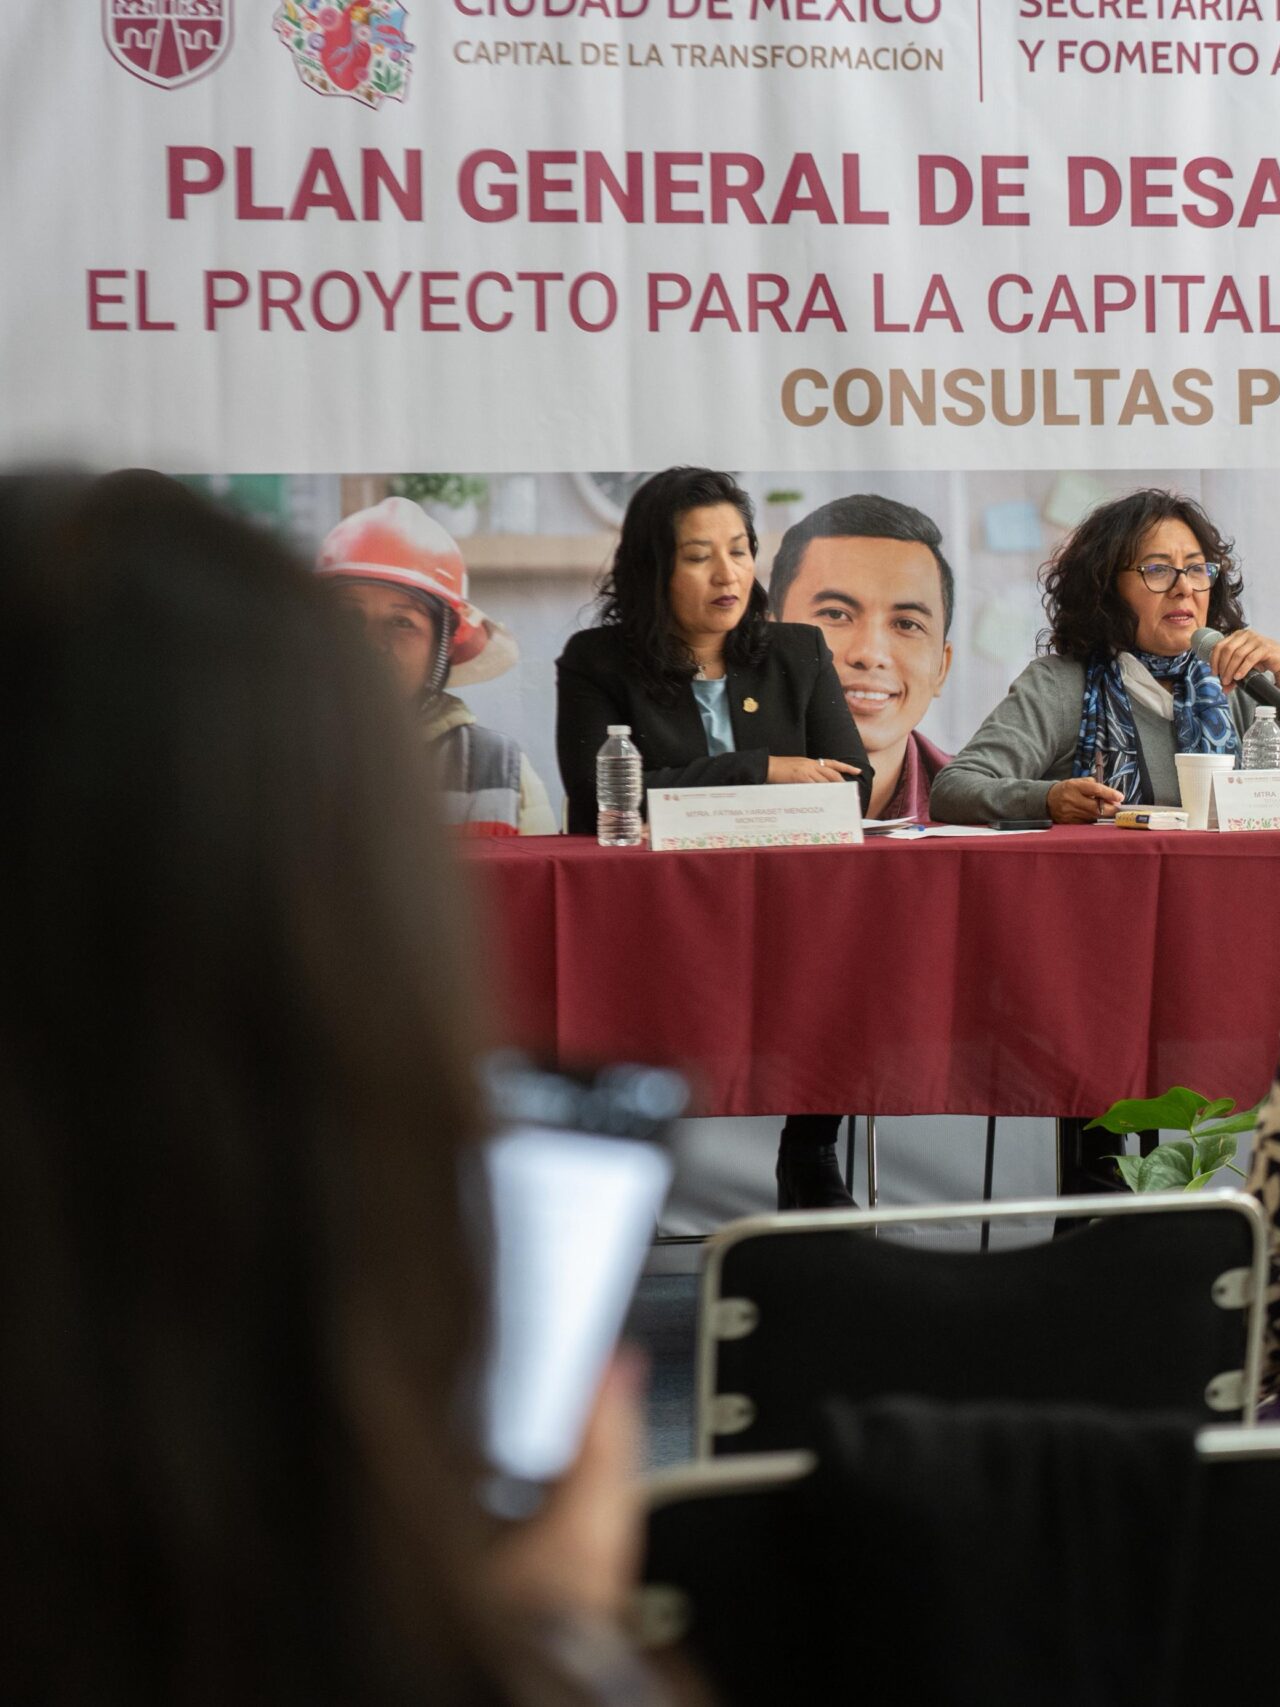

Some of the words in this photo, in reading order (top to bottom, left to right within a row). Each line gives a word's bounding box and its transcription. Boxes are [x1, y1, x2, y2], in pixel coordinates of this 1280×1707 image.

[453, 40, 573, 67] CAPITAL
[580, 43, 620, 67] DE
[628, 43, 665, 68] LA
[671, 42, 945, 72] TRANSFORMACIÓN
[1018, 39, 1046, 73] Y
[1057, 40, 1260, 76] FOMENTO
[166, 145, 425, 223] PLAN
[457, 149, 890, 227] GENERAL
[918, 155, 1031, 228] DE
[87, 269, 177, 332] EL
[204, 270, 620, 334] PROYECTO
[647, 273, 849, 333] PARA
[873, 274, 966, 334] LA
[781, 367, 1215, 428] CONSULTAS
